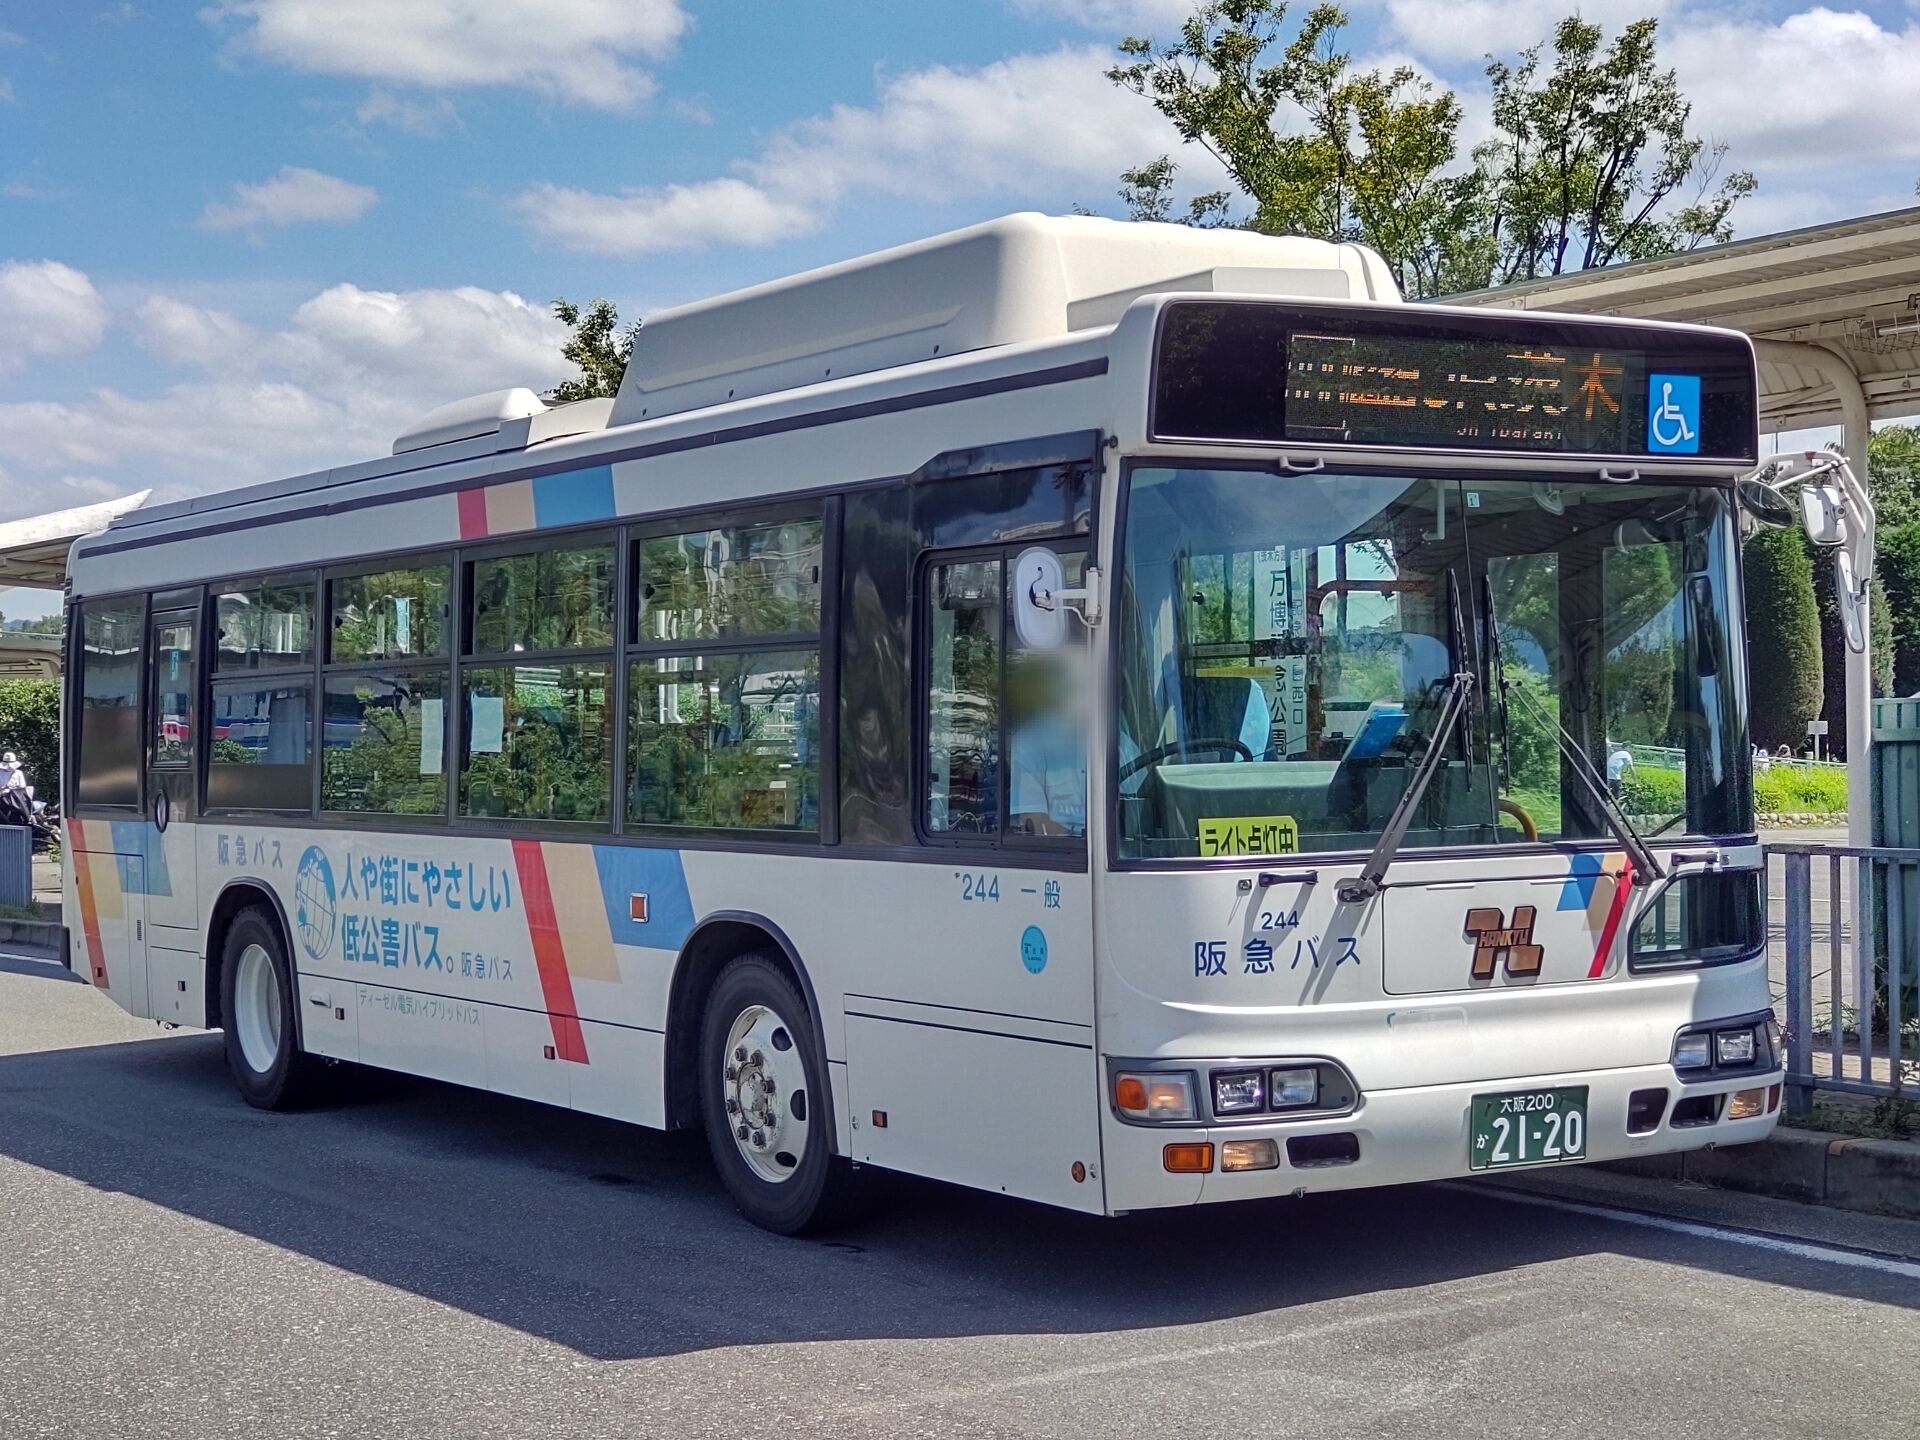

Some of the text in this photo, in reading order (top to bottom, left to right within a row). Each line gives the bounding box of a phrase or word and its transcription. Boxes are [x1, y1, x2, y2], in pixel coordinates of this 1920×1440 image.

[217, 833, 284, 870] 阪急バス
[1204, 824, 1294, 857] ライト点灯中
[340, 852, 512, 913] 人や街にやさしい
[962, 873, 1061, 909] 244 一般
[1260, 910, 1300, 931] 244
[1478, 928, 1530, 948] HANKYU
[461, 951, 513, 982] 阪急バス
[1195, 936, 1361, 977] 阪急バス
[359, 988, 481, 1027] ディーゼル電気ハイブリッドバス
[1500, 1094, 1554, 1113] 大阪200
[1491, 1110, 1583, 1162] 21-20
